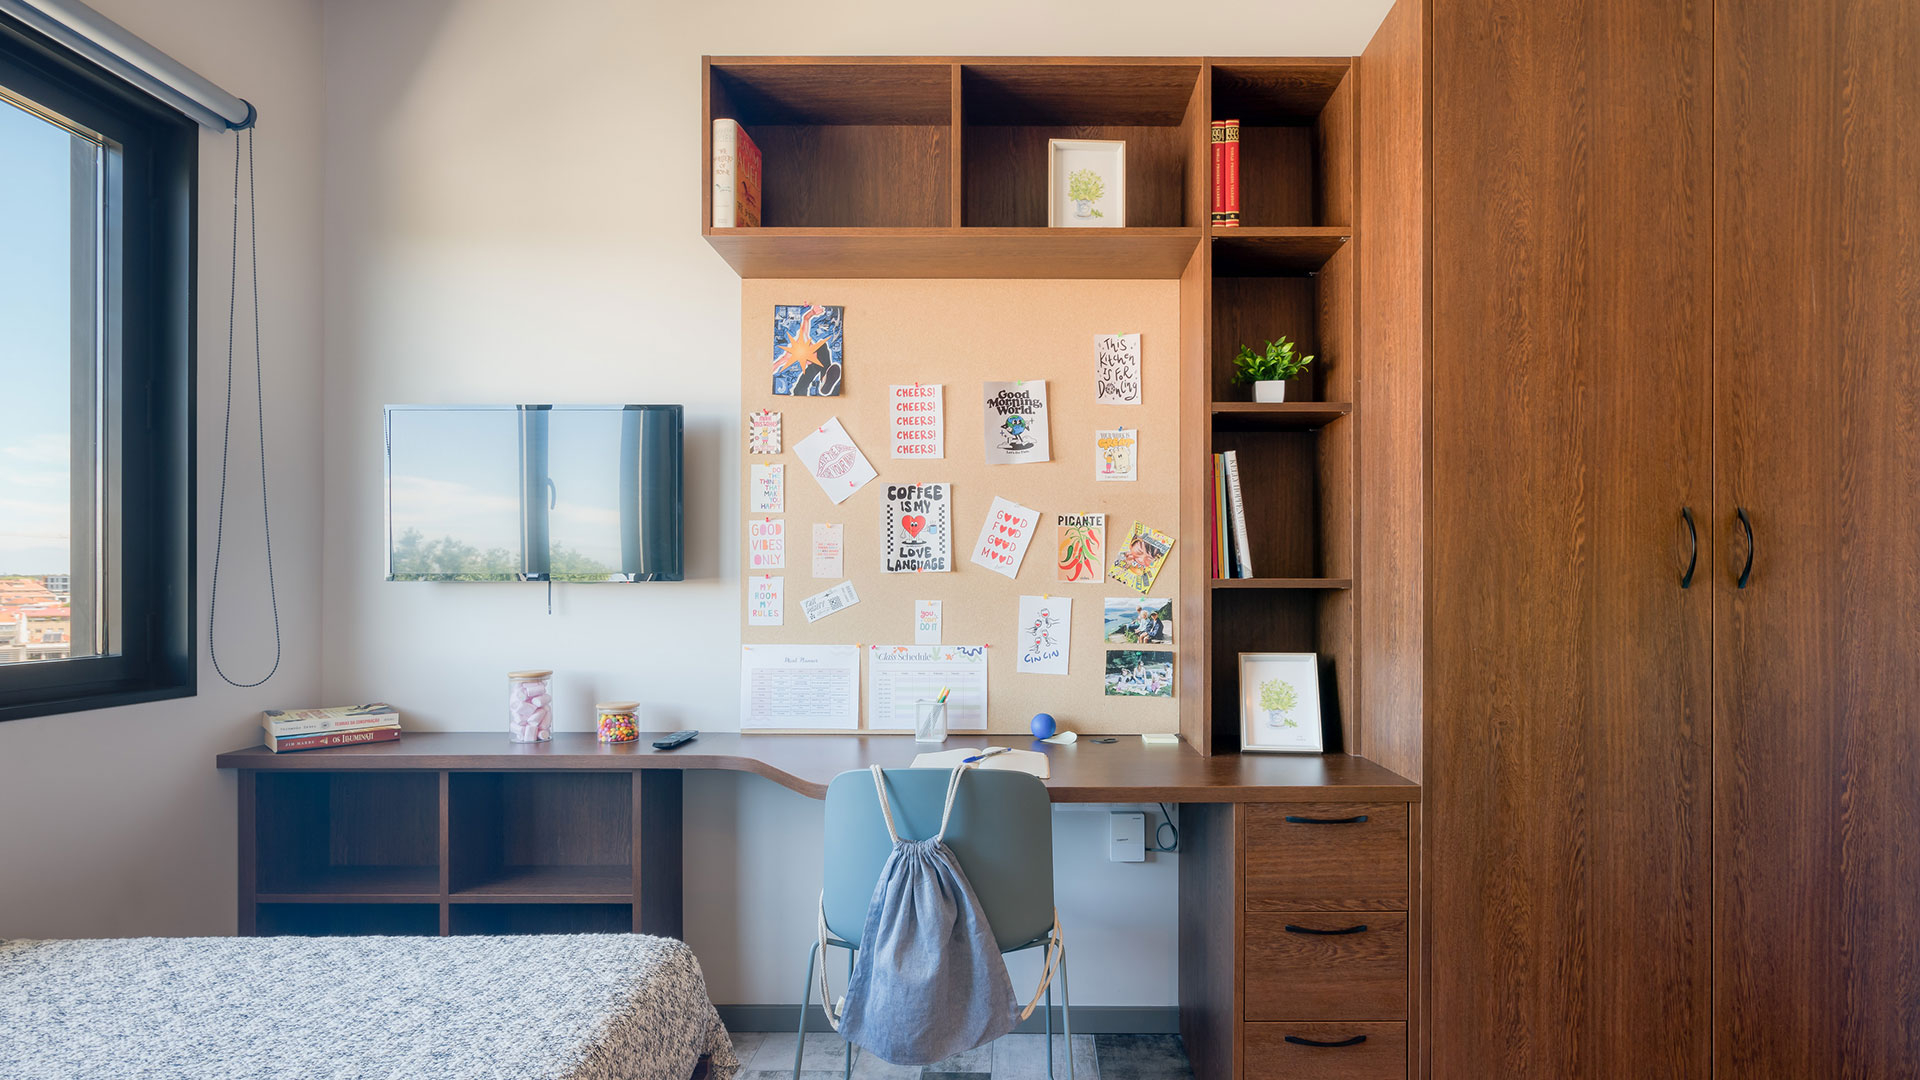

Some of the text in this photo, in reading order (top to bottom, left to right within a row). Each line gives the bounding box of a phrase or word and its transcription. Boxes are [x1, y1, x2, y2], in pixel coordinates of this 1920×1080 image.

[896, 387, 936, 398] CHEERS!
[998, 389, 1029, 399] Good
[896, 402, 936, 412] CHEERS!
[987, 397, 1043, 409] Morning,
[997, 406, 1035, 415] World.
[896, 416, 936, 426] CHEERS!
[896, 430, 936, 440] CHEERS!
[896, 444, 936, 454] CHEERS!
[1098, 438, 1135, 450] GREAT
[1230, 459, 1238, 483] KELLY
[888, 485, 943, 500] COFFEE
[1233, 484, 1243, 515] HOPPEN
[901, 500, 930, 514] IS MY
[1058, 516, 1102, 526] PICANTE
[751, 523, 782, 536] GOOD
[752, 539, 782, 550] VIBES
[900, 547, 931, 558] LOVE
[754, 554, 780, 565] ONLY
[887, 557, 944, 571] LANGUAGE
[752, 609, 779, 617] RULES
[920, 623, 937, 631] DO IT
[878, 652, 929, 661] Class Schedule
